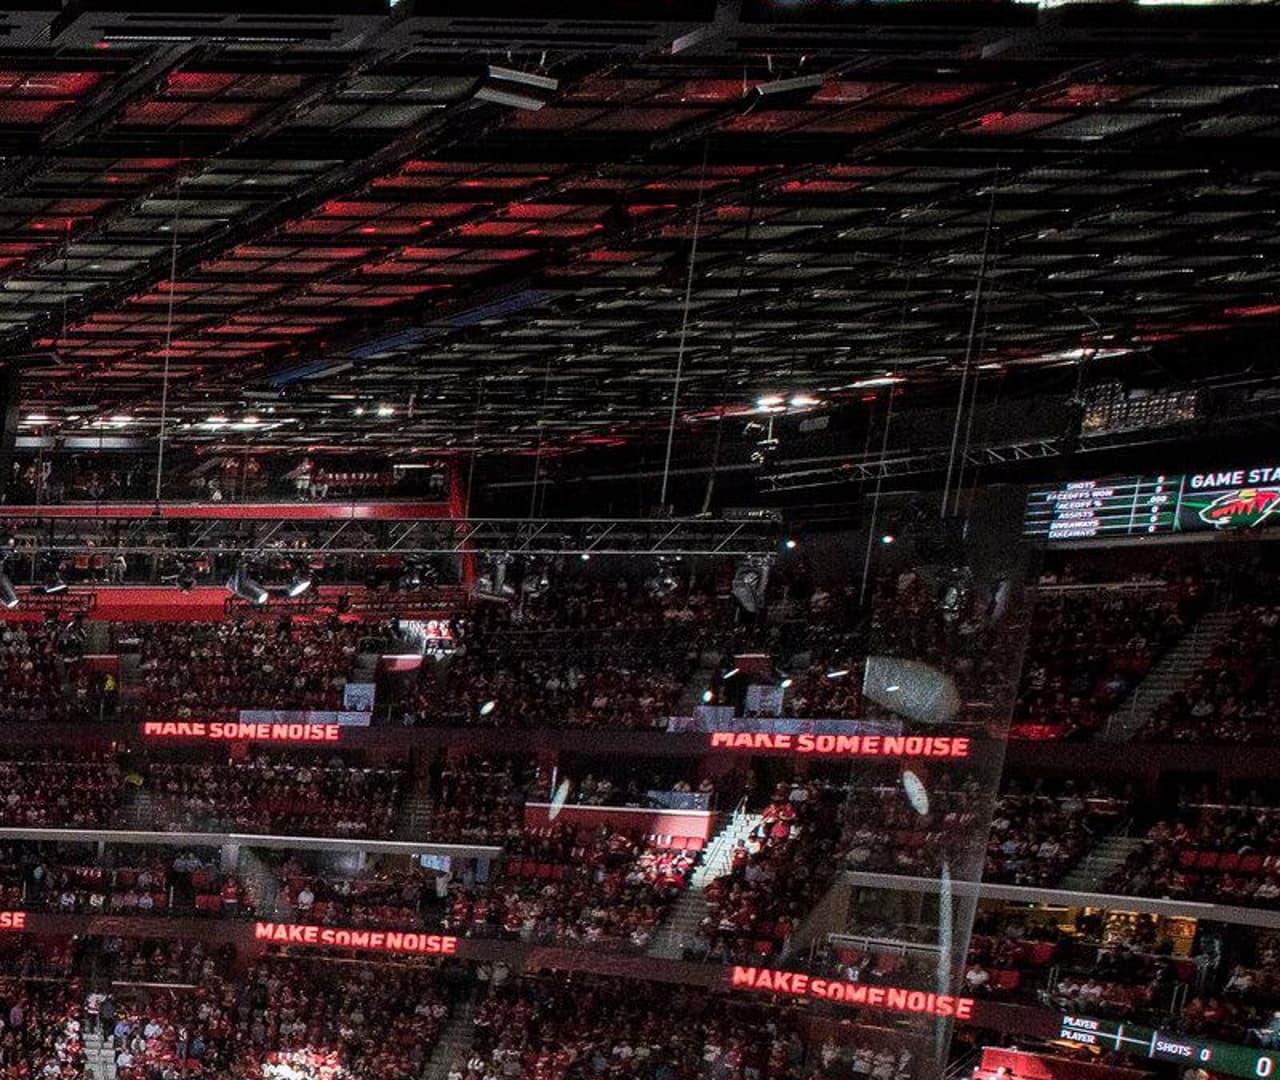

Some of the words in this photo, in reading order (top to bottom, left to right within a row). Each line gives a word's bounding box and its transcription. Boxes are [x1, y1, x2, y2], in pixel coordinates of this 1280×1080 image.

[1191, 471, 1245, 489] GAME
[144, 721, 205, 736] MAKE
[209, 722, 271, 738] SOME
[272, 724, 339, 740] NOISE
[711, 732, 792, 750] MAKE
[797, 733, 880, 754] SOME
[885, 736, 970, 757] NOISE
[255, 923, 318, 943] MAKE
[322, 930, 385, 947] SOME
[386, 932, 457, 954] NOISE
[733, 966, 810, 994] MAKE
[811, 979, 886, 1005] SOME
[888, 989, 974, 1018] NOISE
[1063, 1016, 1099, 1030] PLAYER
[1060, 1030, 1096, 1044] PLAYER
[1156, 1042, 1191, 1057] SHOTS
[1255, 1057, 1274, 1077] 0
